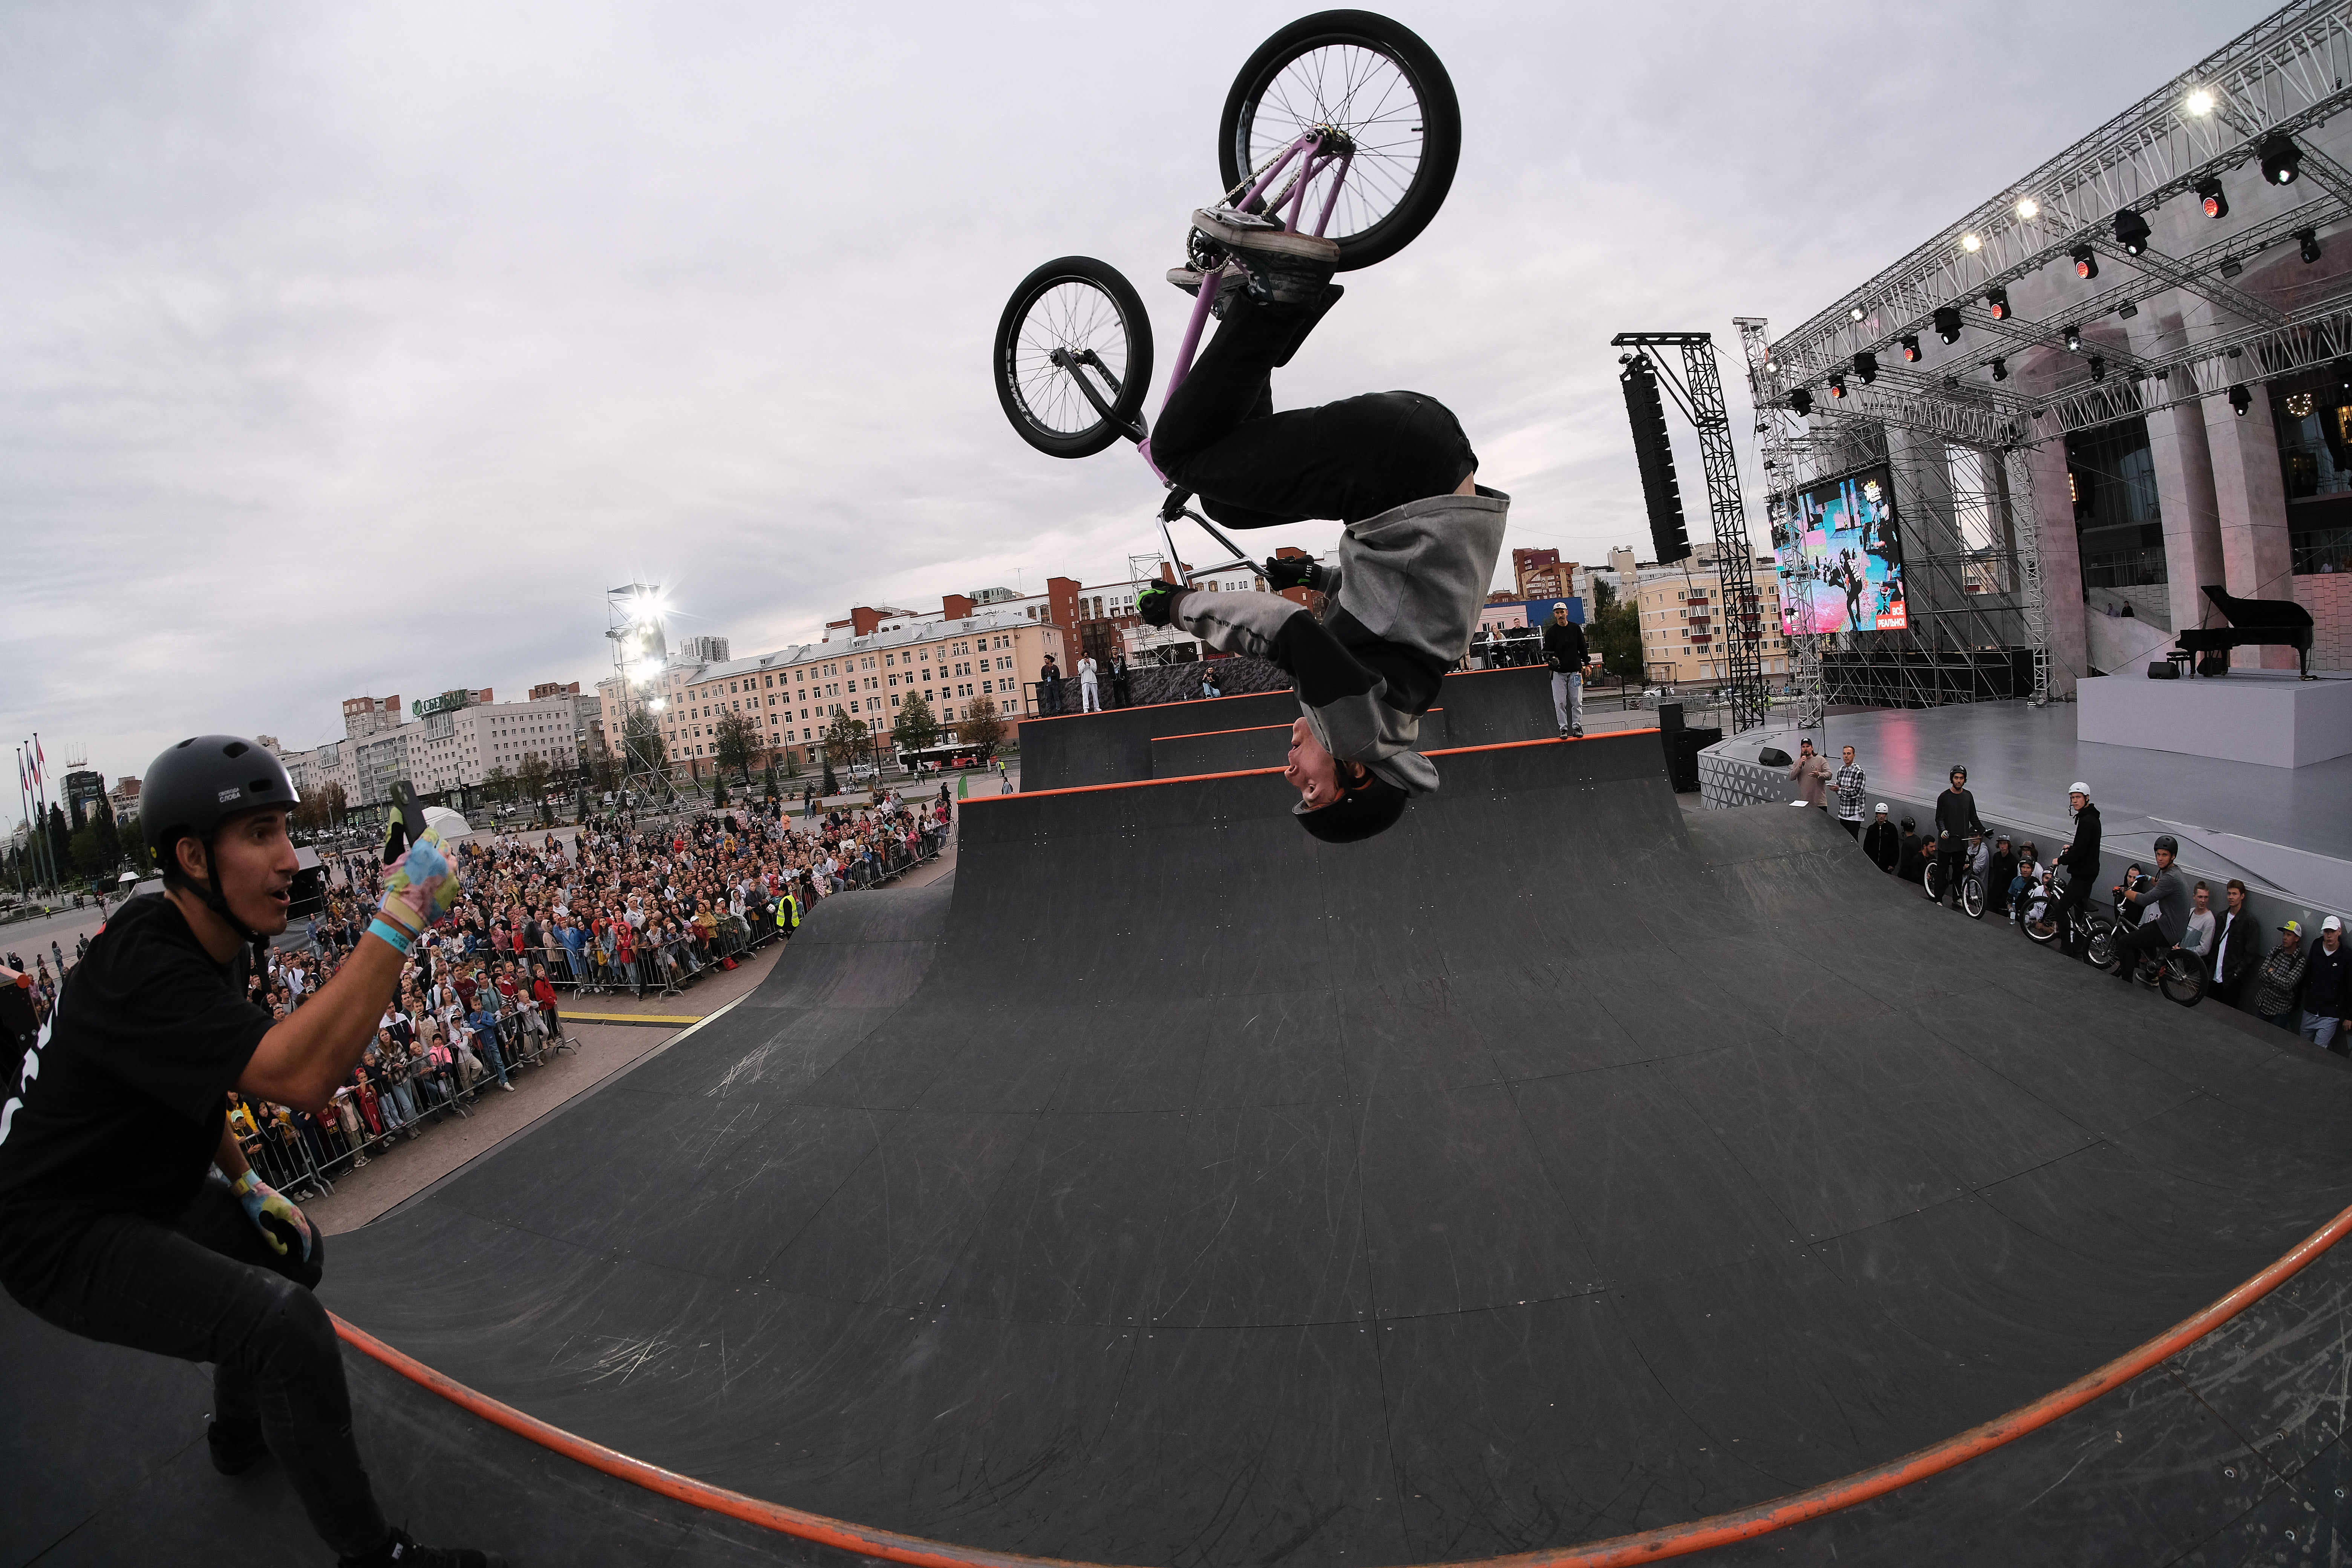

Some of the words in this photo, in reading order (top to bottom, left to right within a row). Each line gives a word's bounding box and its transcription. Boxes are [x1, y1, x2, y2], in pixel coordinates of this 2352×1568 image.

[1892, 604, 1904, 616] ВСЁ
[1877, 618, 1905, 628] РЕАЛЬНО!
[424, 689, 468, 712] СБЕРБАНК
[219, 792, 241, 802] СЛОВА
